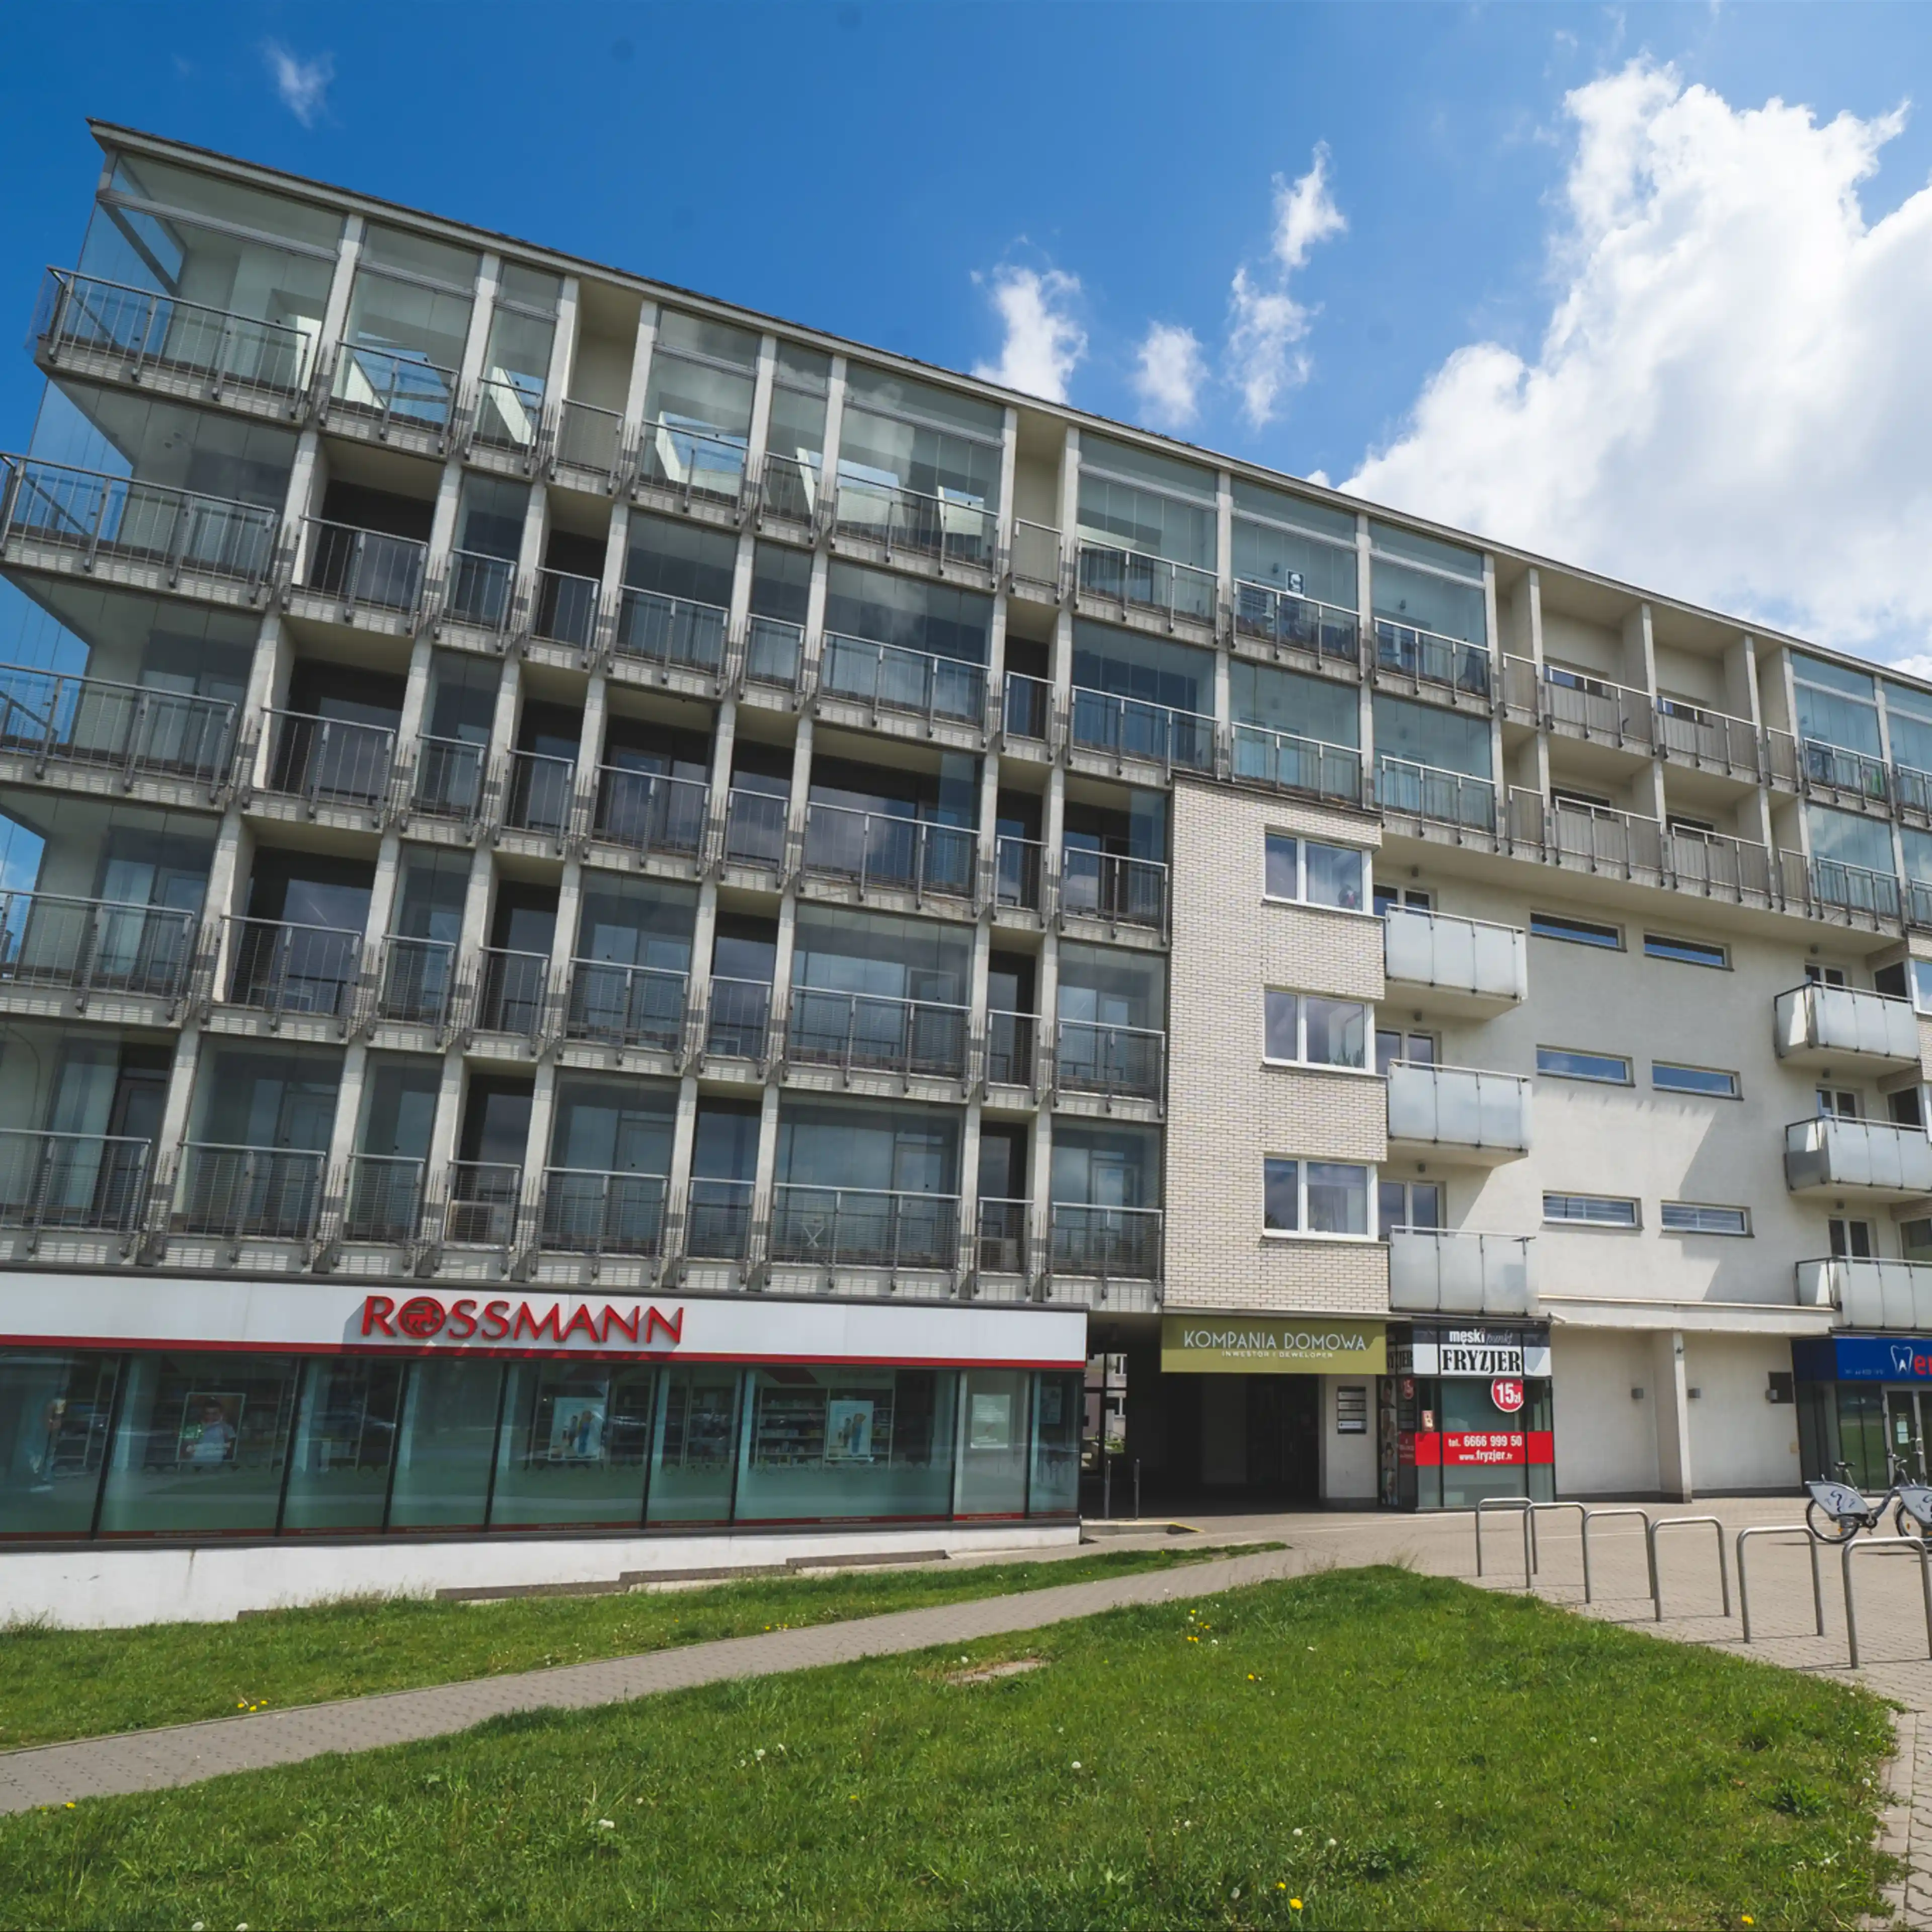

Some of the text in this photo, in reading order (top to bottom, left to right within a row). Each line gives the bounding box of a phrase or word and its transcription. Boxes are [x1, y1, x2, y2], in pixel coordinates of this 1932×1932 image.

[361, 1295, 684, 1344] ROSSMANN
[1184, 1330, 1366, 1350] KOMPANIA DOMOWA
[1442, 1349, 1521, 1374] FRYZJER
[1490, 1435, 1508, 1447] 999
[1510, 1435, 1522, 1447] 50
